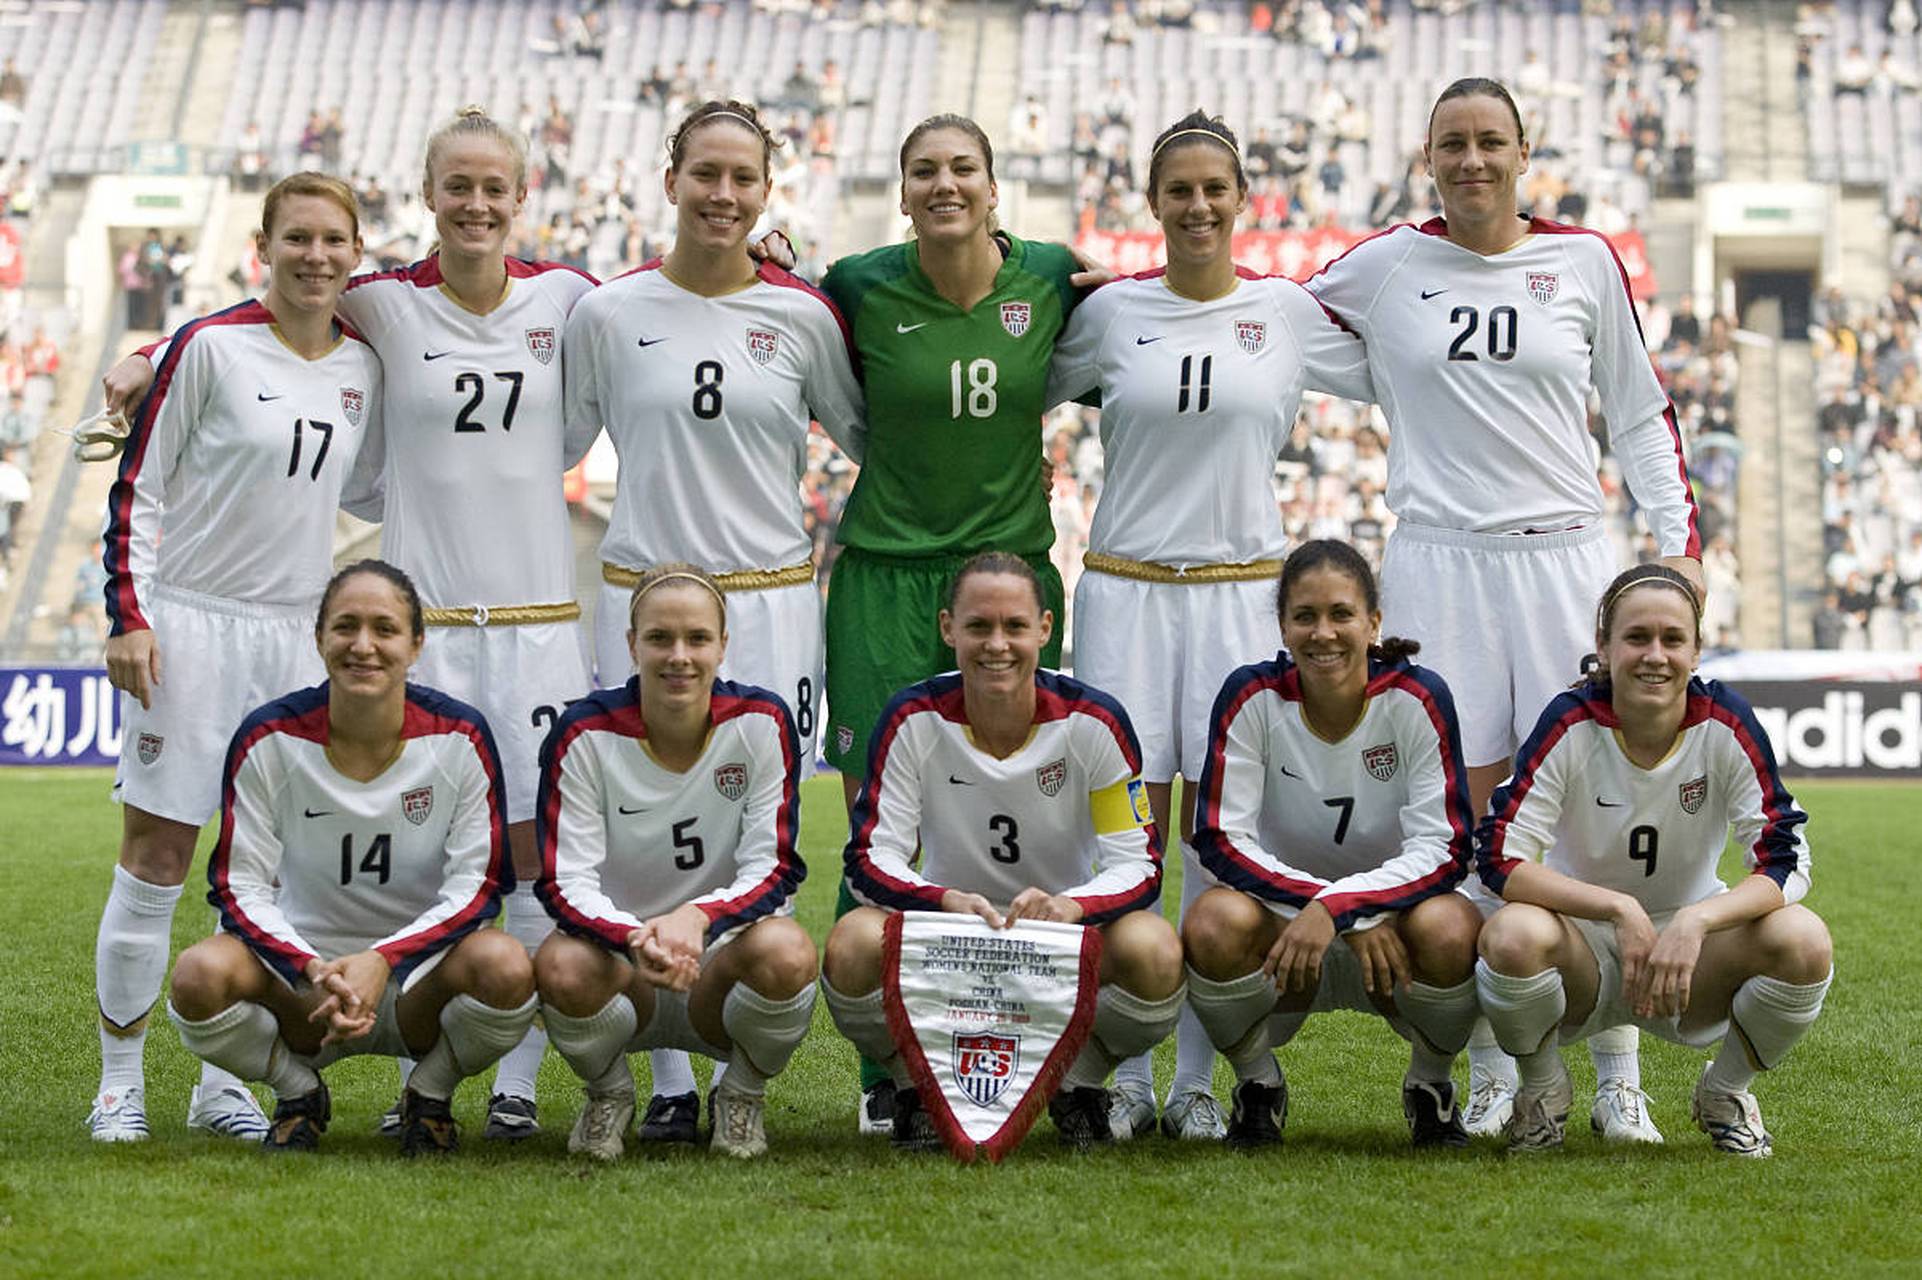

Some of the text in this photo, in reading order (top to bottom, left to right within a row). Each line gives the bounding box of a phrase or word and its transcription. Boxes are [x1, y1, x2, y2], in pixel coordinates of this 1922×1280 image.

[1447, 307, 1518, 361] 20
[455, 372, 524, 433] 27
[693, 361, 724, 420] 8
[951, 358, 998, 418] 18
[1178, 355, 1212, 413] 11
[288, 419, 333, 481] 17
[2, 672, 122, 758] 幼儿
[797, 676, 813, 738] 8
[672, 816, 705, 872] 5
[988, 813, 1021, 865] 3
[1323, 796, 1355, 847] 7
[341, 832, 392, 887] 14
[1628, 824, 1659, 879] 9
[926, 946, 1050, 965] SOCCER FEDERATION
[942, 935, 1035, 951] UNITED STATES
[970, 961, 1022, 975] NATIONAL
[1029, 964, 1056, 977] TEAM
